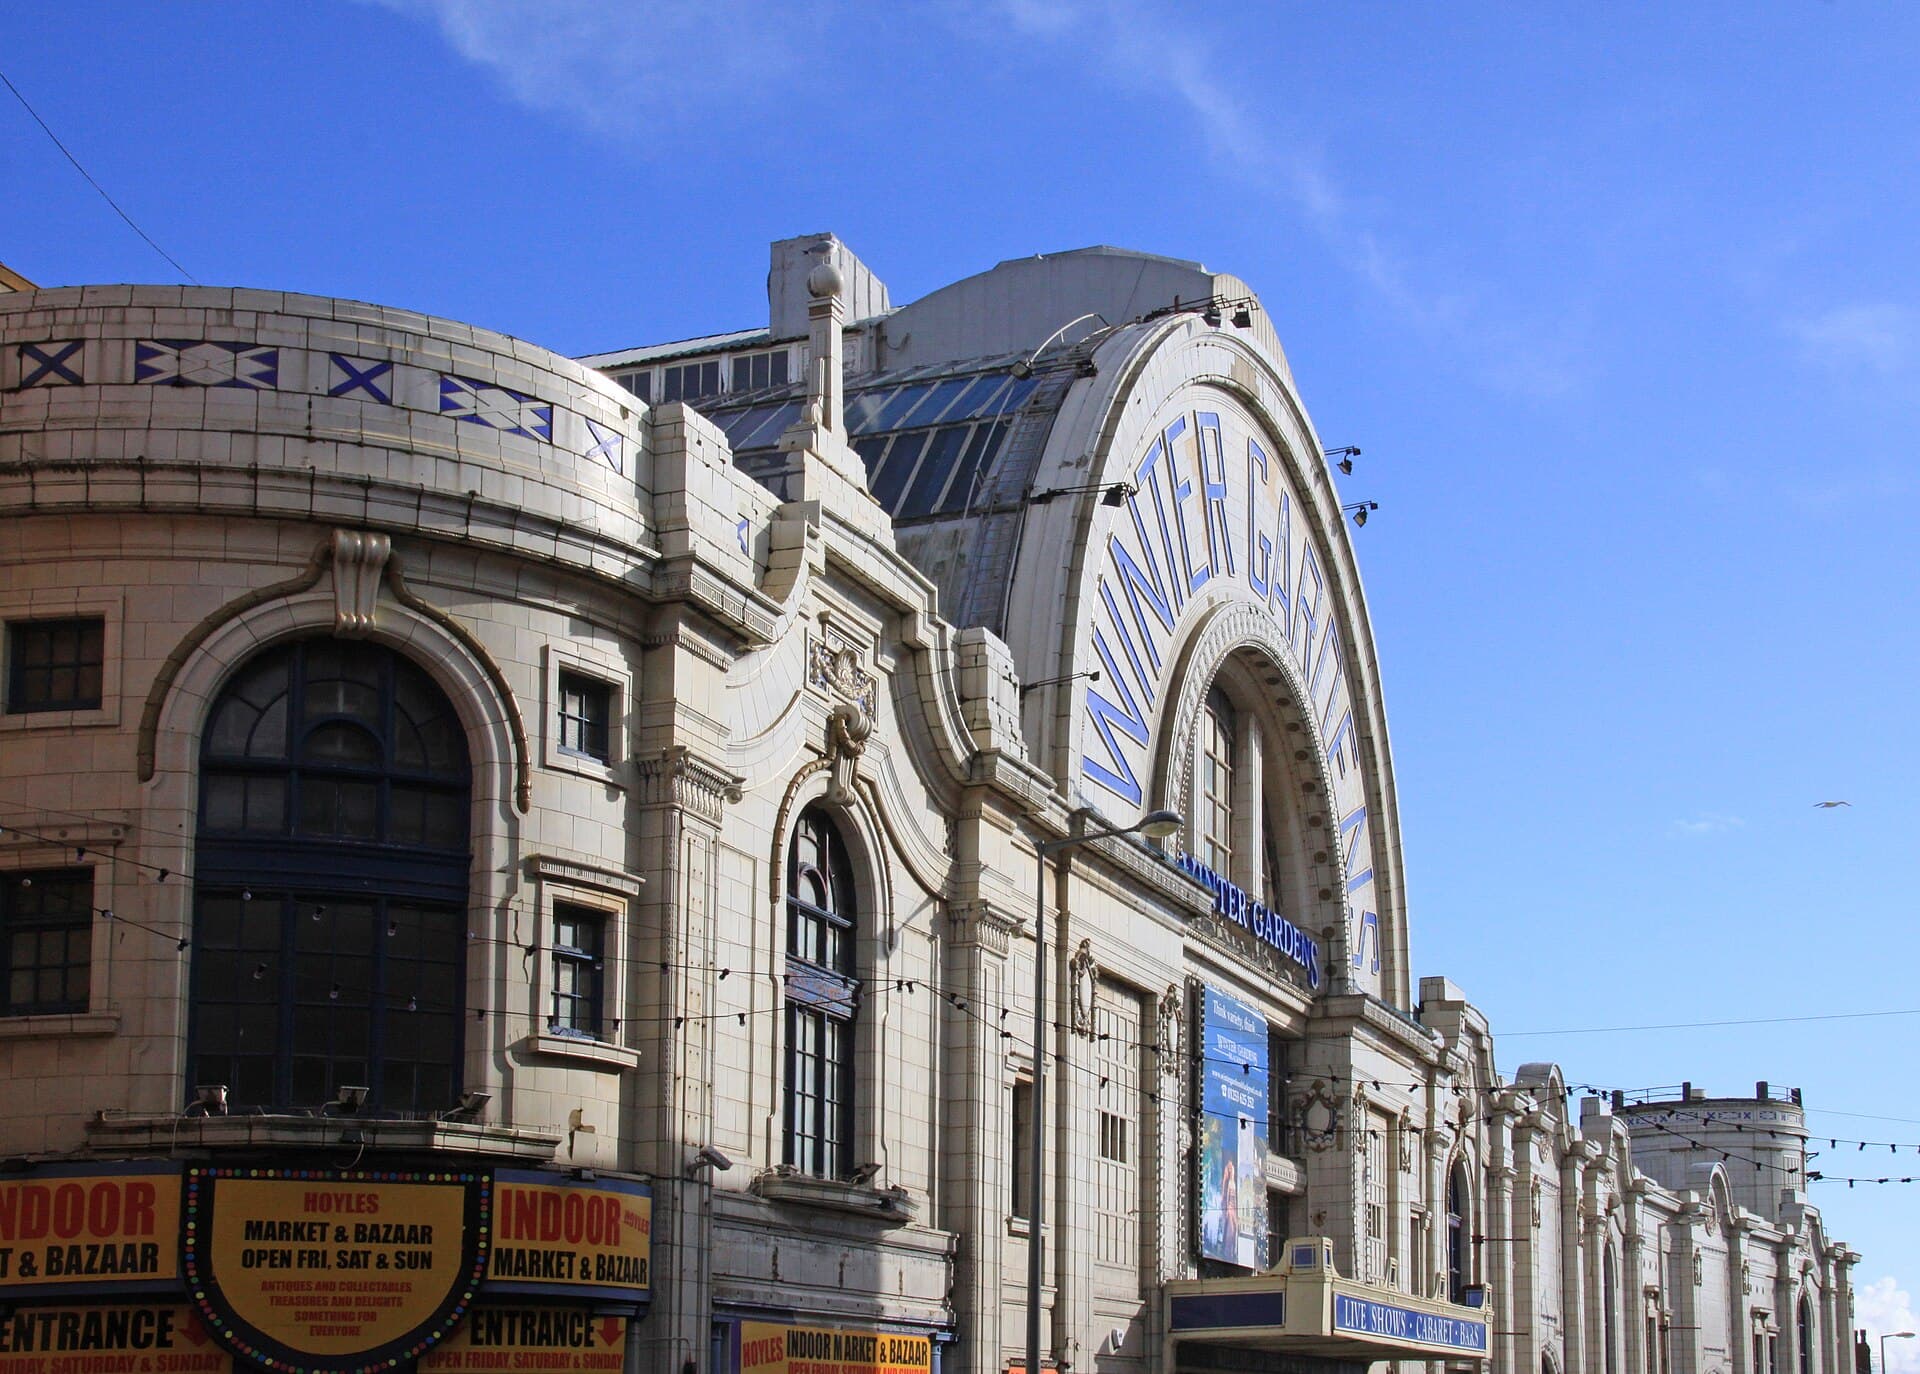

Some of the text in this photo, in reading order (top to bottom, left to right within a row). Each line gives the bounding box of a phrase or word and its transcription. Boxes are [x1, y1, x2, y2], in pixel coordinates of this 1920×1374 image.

[1082, 410, 1381, 975] WINTER GARDENS
[1253, 902, 1319, 989] GARDENS
[304, 1192, 379, 1213] HOYLES
[500, 1189, 621, 1246] INDOOR
[245, 1221, 432, 1244] MARKET & BAZAAR
[19, 1252, 37, 1277] &
[46, 1243, 158, 1276] BAZAAR
[242, 1249, 432, 1270] OPEN FRI, SAT & SUN
[494, 1247, 647, 1284] MARKET & BAZAAR
[261, 1281, 412, 1293] ANTIQUES AND COLLECTABLES
[269, 1296, 403, 1307] TREASURES AND DELIGHTS
[294, 1311, 377, 1322] SOMETHING FOR
[470, 1310, 595, 1347] ENTRANCE
[1344, 1298, 1480, 1348] LIVE SHOWS CABARET BARS
[309, 1325, 361, 1336] EVERYONE
[427, 1351, 461, 1369] OPEN
[514, 1352, 571, 1369] SATURDAY
[573, 1356, 580, 1369] &
[582, 1353, 623, 1370] SUNDAY
[743, 1337, 783, 1368] HOYLES
[786, 1329, 831, 1360] INDOOR
[880, 1341, 887, 1363] &
[890, 1338, 928, 1366] BAZAAR
[52, 1355, 136, 1374] SATURDAY
[141, 1357, 152, 1372] &
[157, 1353, 224, 1372] SUNDAY
